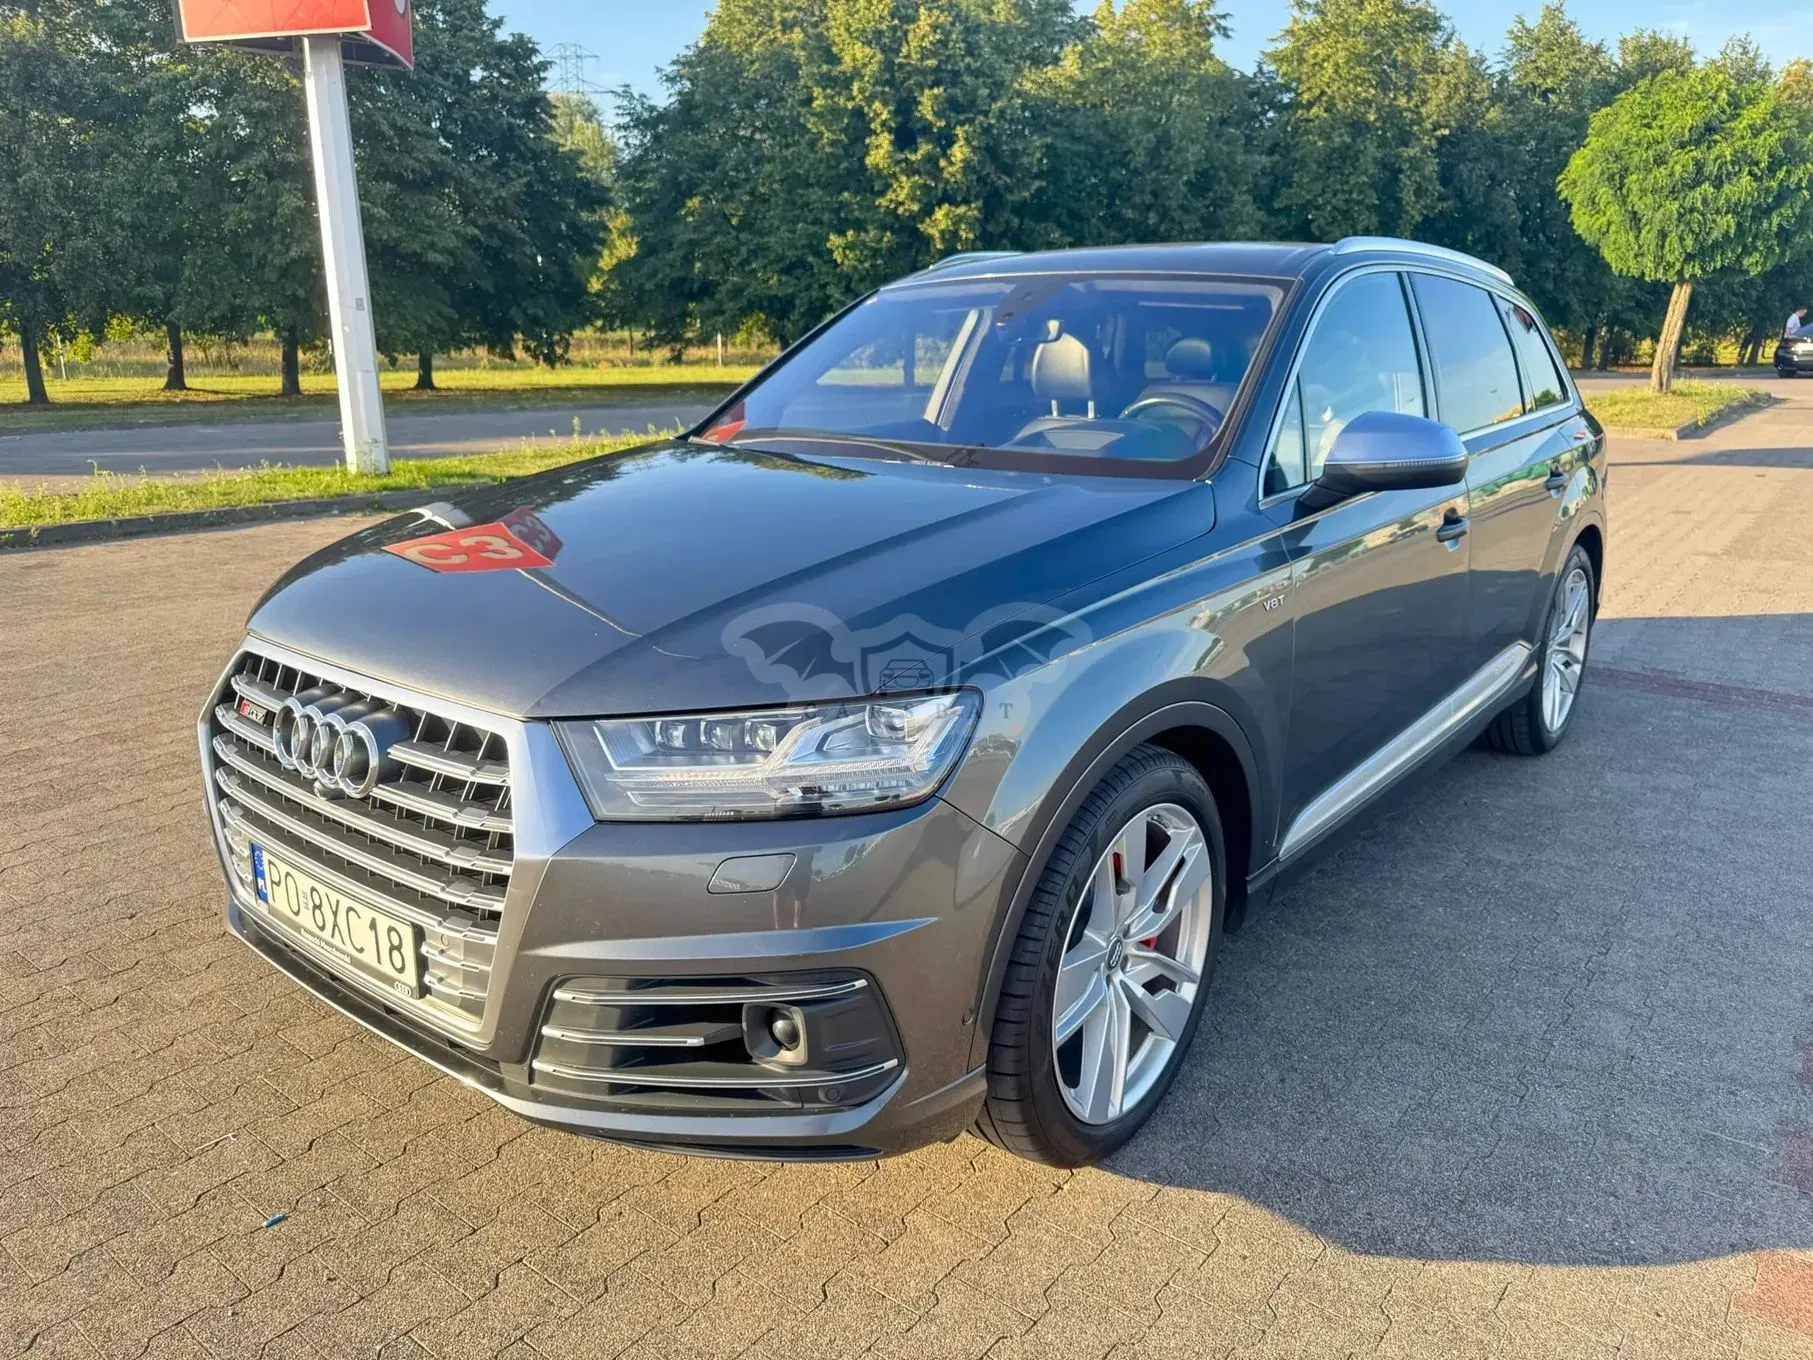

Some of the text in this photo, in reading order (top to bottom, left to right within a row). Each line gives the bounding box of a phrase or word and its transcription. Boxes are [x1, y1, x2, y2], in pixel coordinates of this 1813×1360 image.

[1263, 594, 1285, 612] V8T
[267, 859, 301, 917] PO
[310, 886, 406, 974] 8XC18
